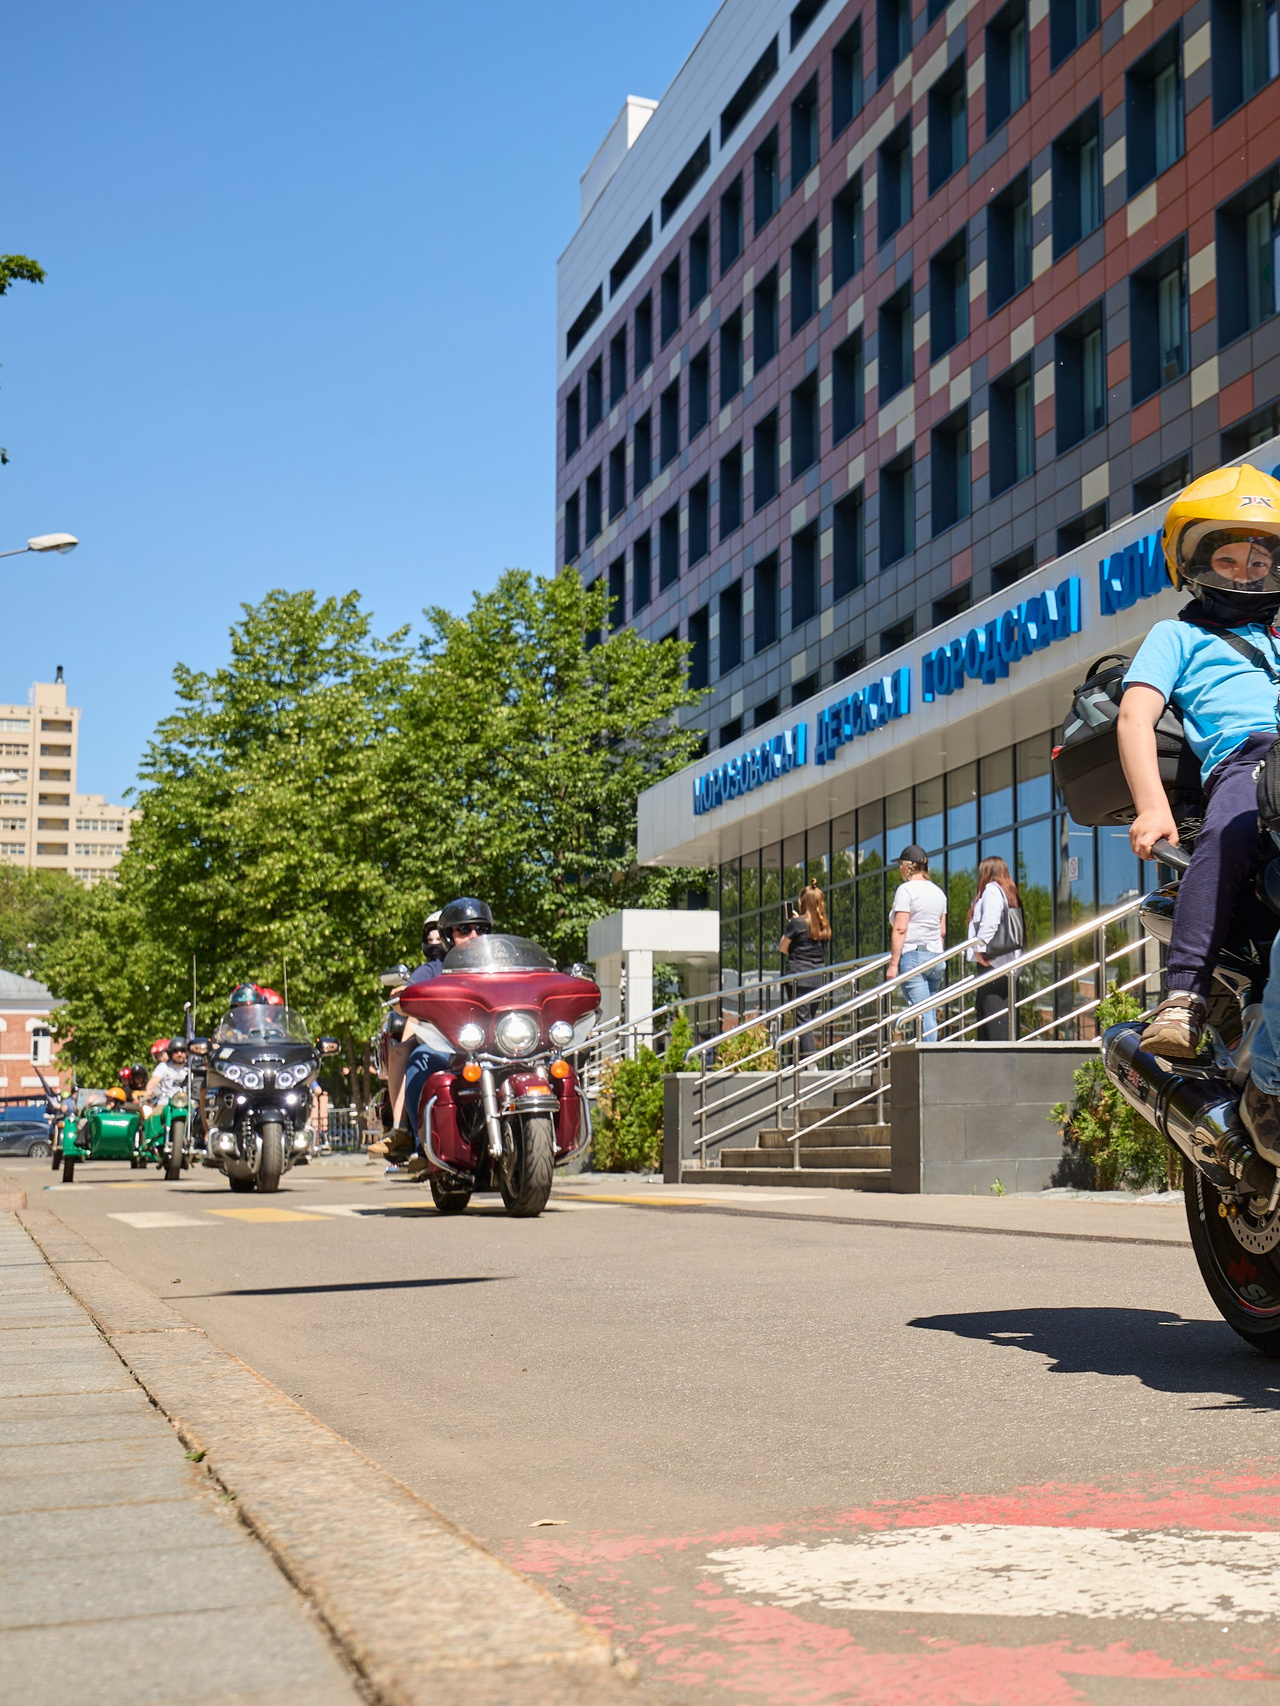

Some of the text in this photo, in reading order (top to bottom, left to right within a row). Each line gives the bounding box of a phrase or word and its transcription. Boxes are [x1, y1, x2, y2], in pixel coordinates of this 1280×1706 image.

[693, 722, 807, 815] МОРОЗОВСКАЯ
[815, 667, 910, 765] ДЕТСКАЯ
[922, 577, 1082, 703] ГОРОДСКАЯ
